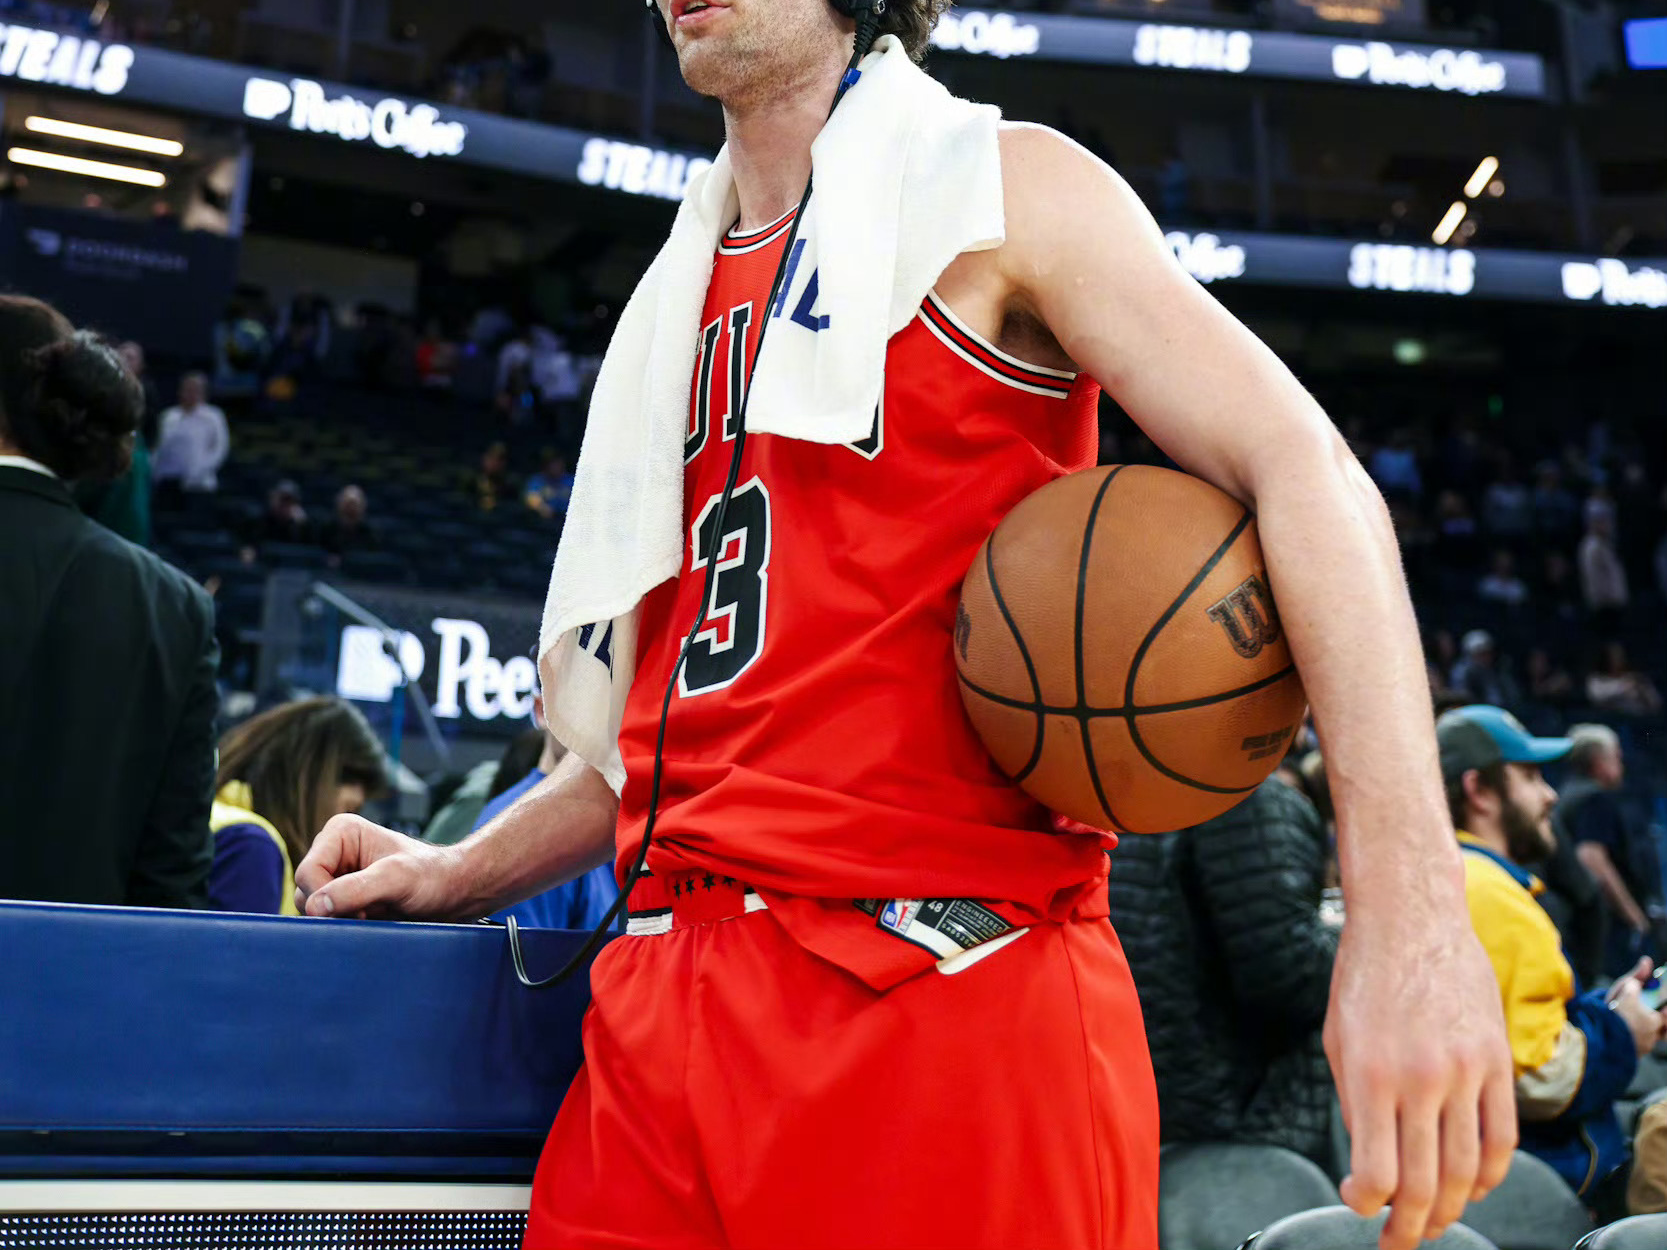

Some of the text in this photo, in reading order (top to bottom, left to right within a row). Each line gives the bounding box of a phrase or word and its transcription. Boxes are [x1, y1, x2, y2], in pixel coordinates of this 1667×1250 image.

[0, 23, 134, 95] TEALS
[678, 475, 772, 698] 3
[431, 617, 540, 720] Pee
[927, 900, 944, 913] 48
